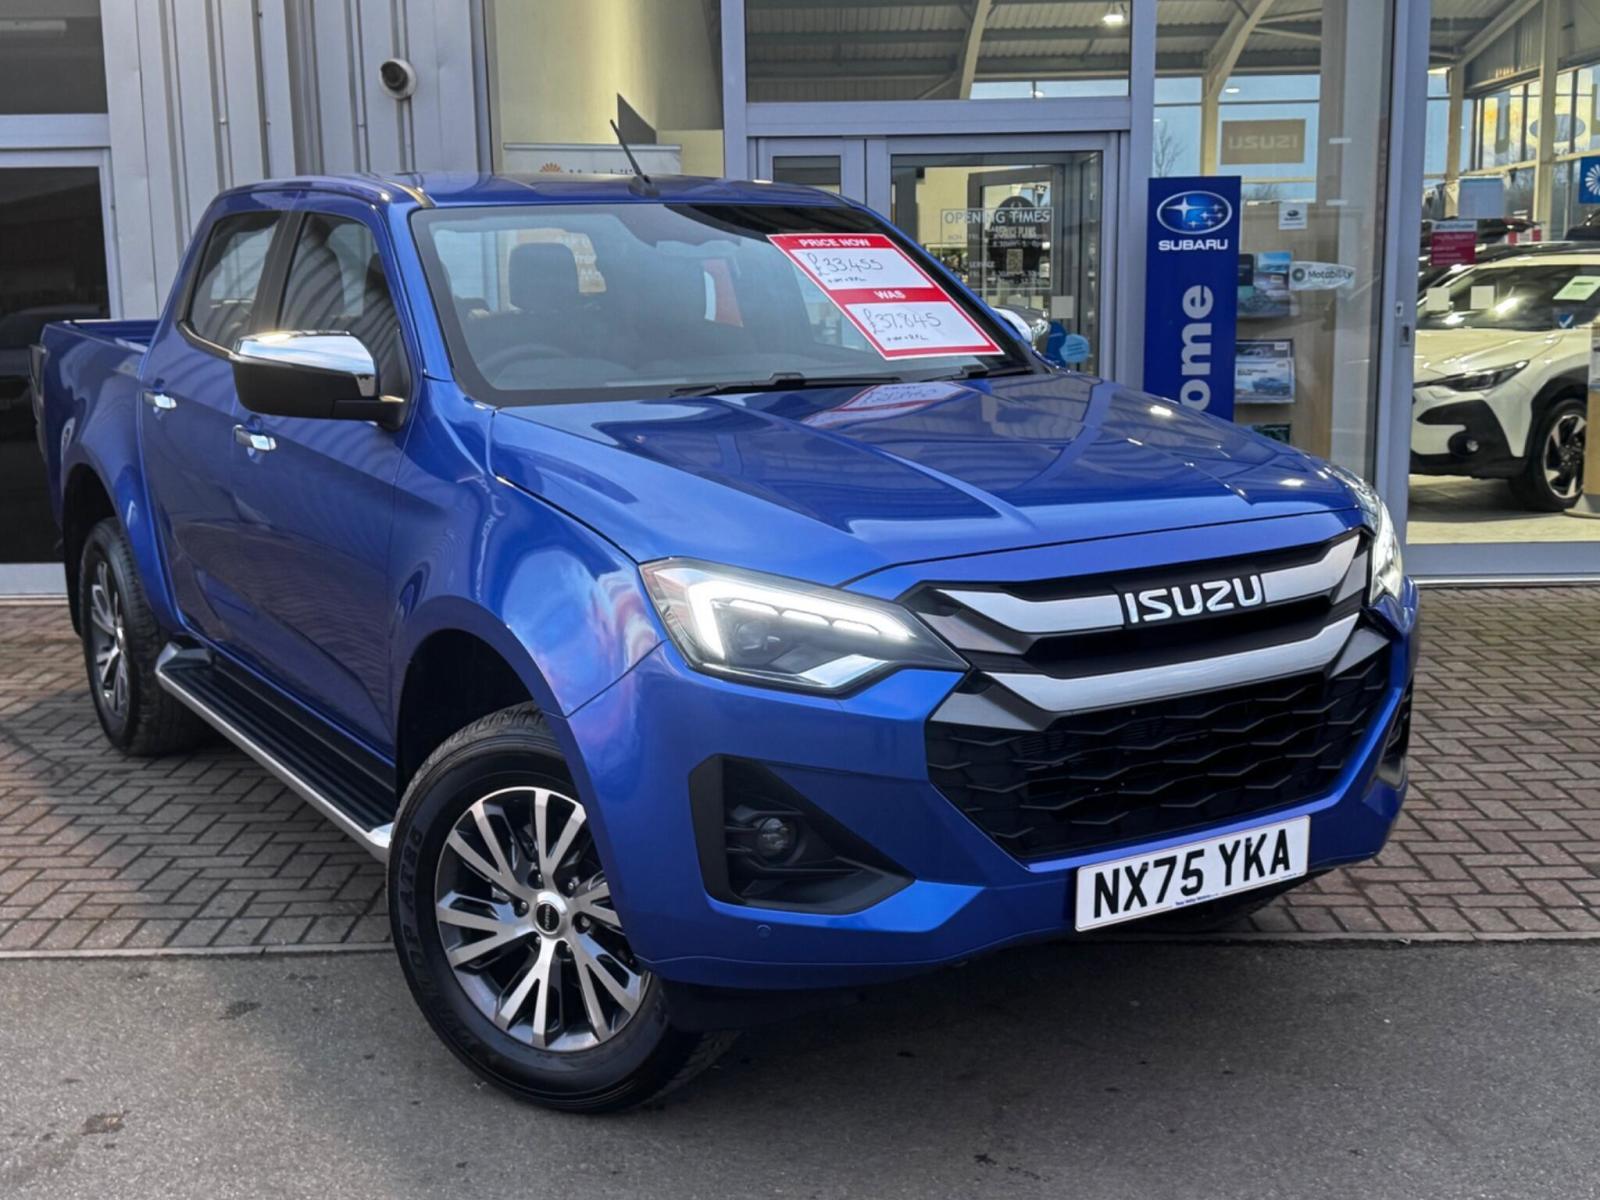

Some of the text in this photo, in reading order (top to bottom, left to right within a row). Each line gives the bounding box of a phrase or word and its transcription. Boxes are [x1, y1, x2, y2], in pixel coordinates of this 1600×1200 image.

[944, 210, 1051, 224] OPENING TIMES
[799, 238, 871, 247] PRICE NOW
[1158, 239, 1228, 251] SUBARU
[873, 290, 906, 300] WAS
[1180, 285, 1214, 411] ome
[1124, 575, 1263, 623] ISUZU
[1094, 829, 1290, 918] NX75 YKA
